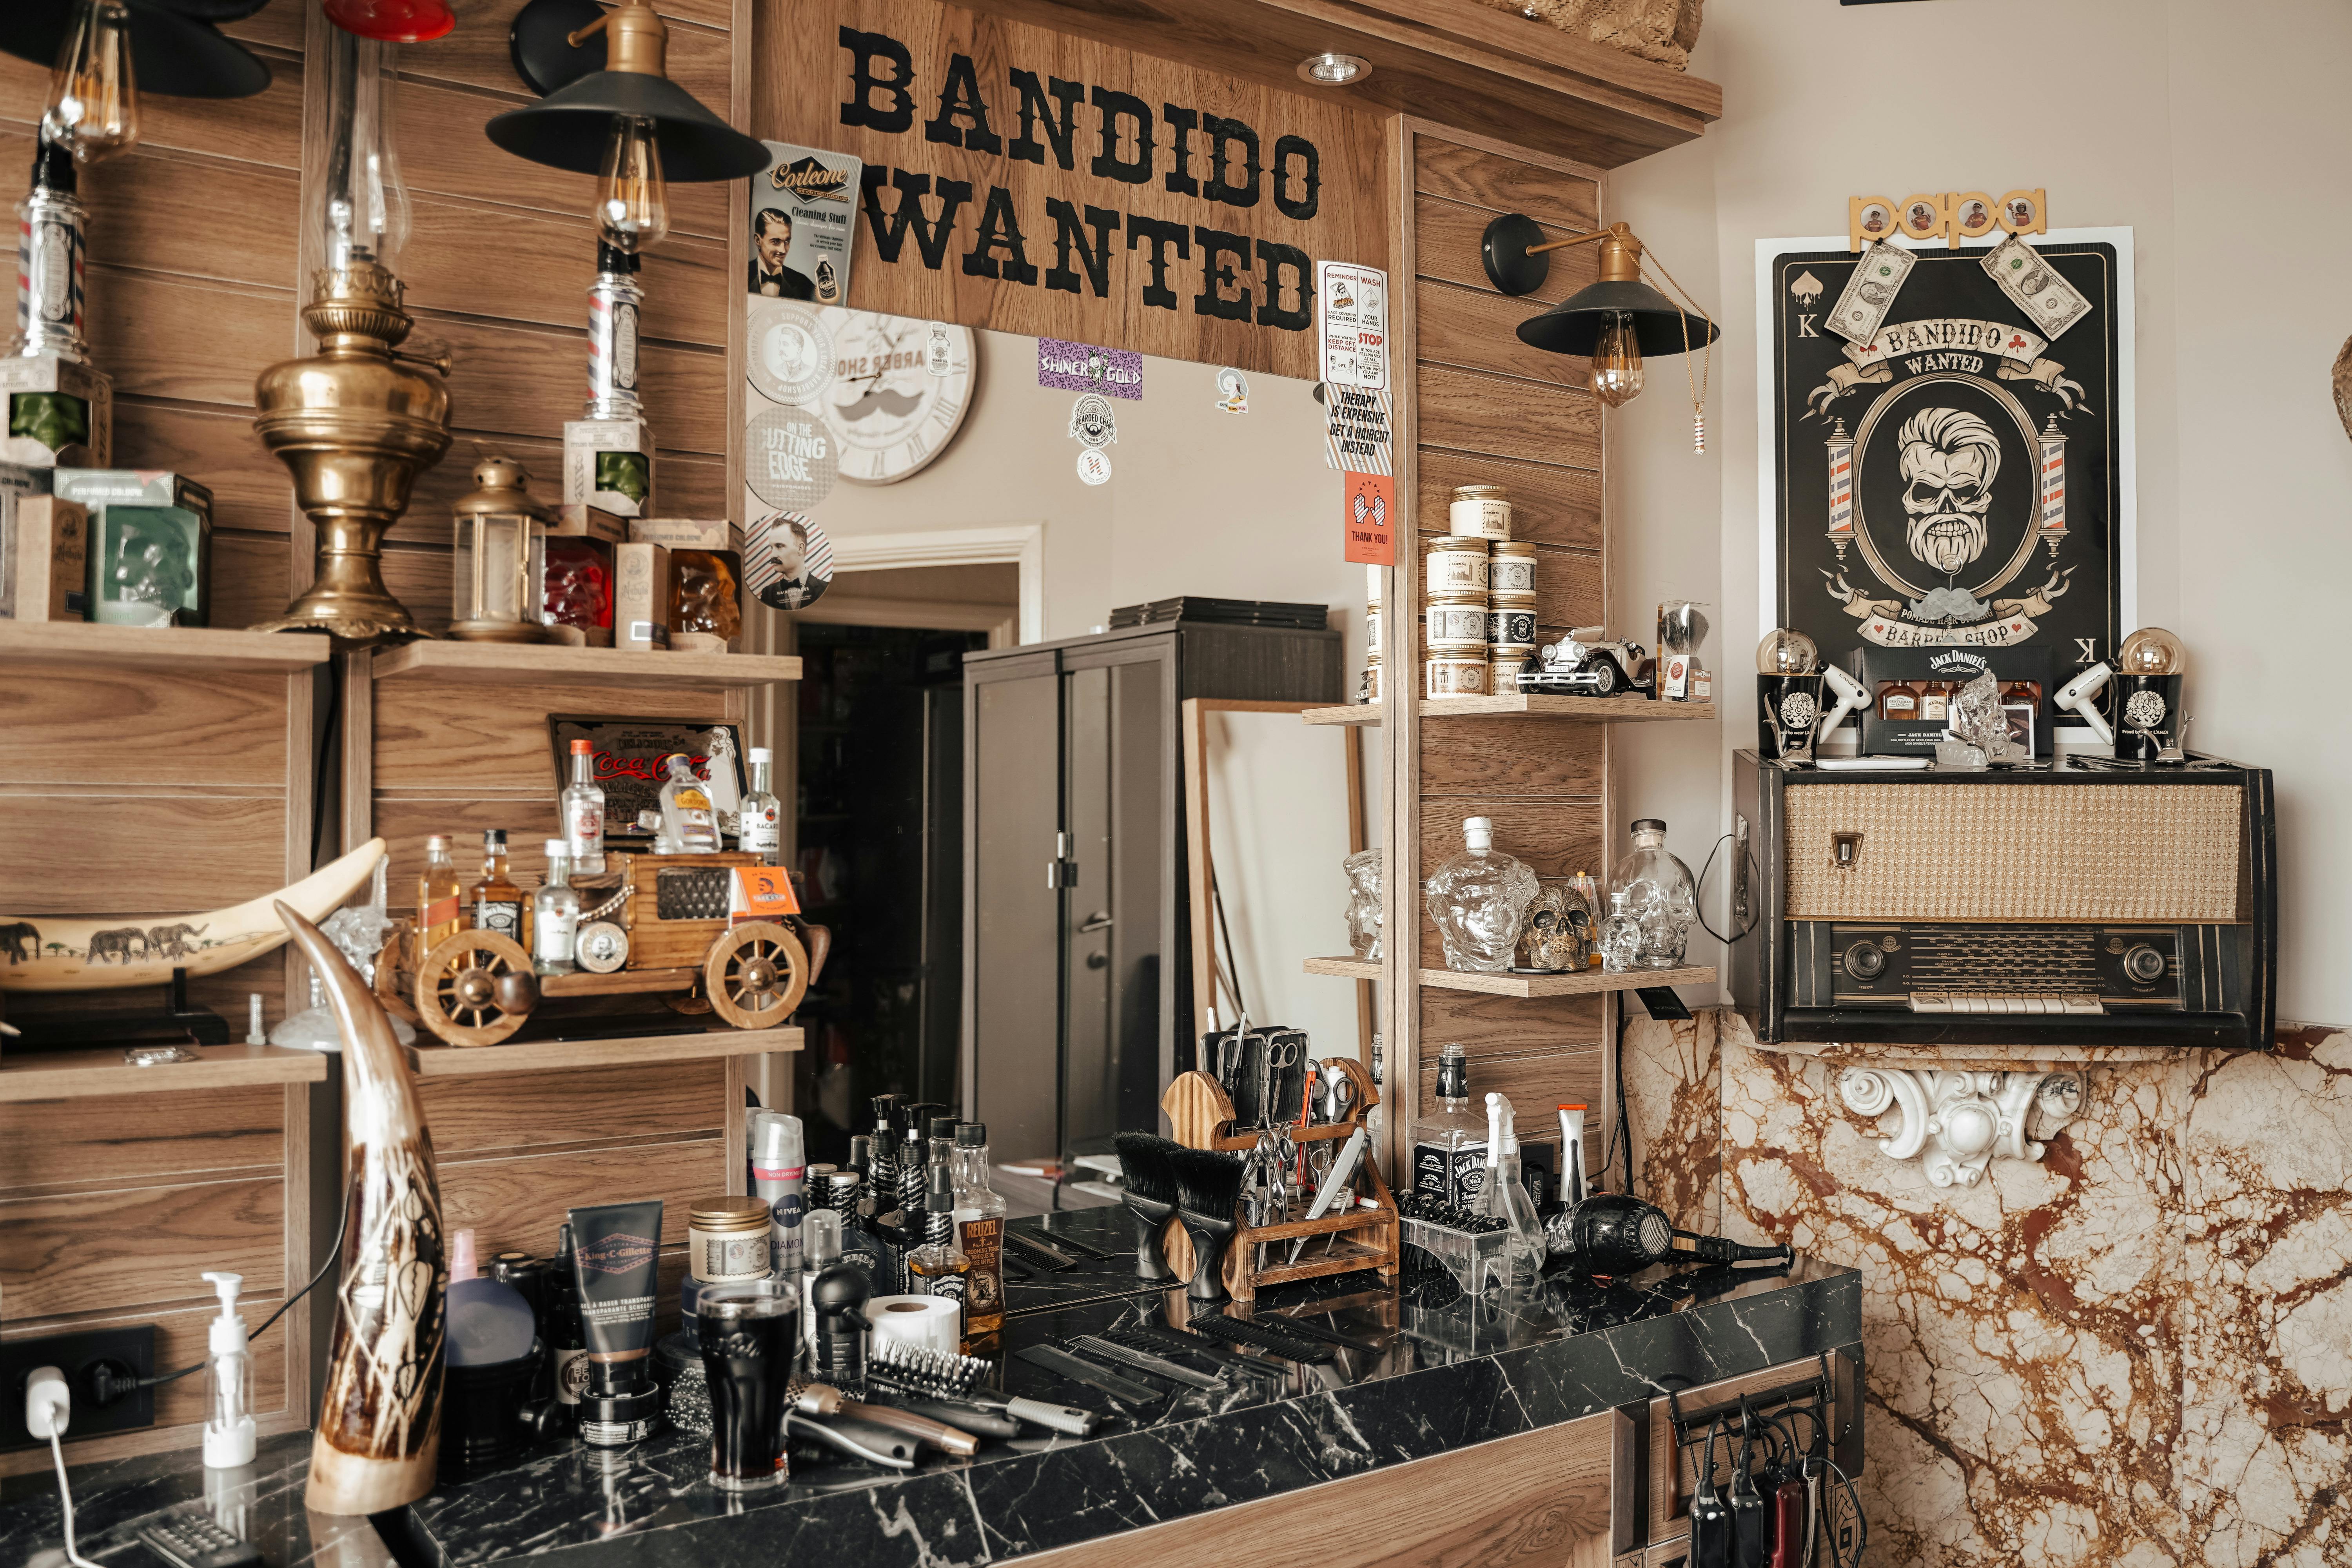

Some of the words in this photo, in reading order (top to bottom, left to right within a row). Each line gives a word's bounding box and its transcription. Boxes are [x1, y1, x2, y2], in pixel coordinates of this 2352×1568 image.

[839, 24, 1323, 221] BANDIDO
[771, 162, 848, 189] Corleone
[791, 207, 826, 222] Cleaning
[829, 211, 846, 224] Stuff
[1849, 189, 2046, 254] papa
[861, 164, 1317, 332] WANTED
[1327, 273, 1357, 281] REMINDER
[1361, 276, 1380, 287] WASH
[1843, 294, 1853, 310] UNITED
[1851, 278, 1861, 295] STATES
[1862, 255, 1875, 273] AMERICA
[782, 312, 814, 329] SUPPORT
[1797, 314, 1819, 338] K
[811, 328, 826, 348] YOUR
[1359, 332, 1382, 347] STOP
[1885, 322, 2002, 353] BANDIDO
[1328, 344, 1356, 352] DISTANCE
[819, 350, 828, 371] LOCAL
[1904, 353, 1984, 376] WANTED
[1041, 356, 1089, 377] SHINER
[1106, 366, 1141, 385] GOLD
[778, 370, 823, 394] BARBERSHOP
[1341, 392, 1376, 408] THERAPY
[1076, 414, 1098, 426] BEARDED
[1100, 416, 1112, 430] CHAP
[1331, 405, 1339, 417] IS
[1341, 407, 1385, 425] EXPENSIVE
[786, 422, 797, 433] ON
[799, 423, 813, 437] THE
[1330, 423, 1346, 437] GET
[1347, 426, 1353, 437] A
[1355, 426, 1389, 443] HAIRCUT
[759, 427, 826, 460] CUTTING
[1341, 440, 1375, 456] INSTEAD
[768, 450, 813, 482] EDGE
[73, 487, 110, 496] PERFUMED
[111, 488, 144, 496] COLOGNE
[1351, 531, 1372, 543] THANK
[1374, 534, 1388, 544] YOU!
[1512, 615, 1531, 624] BANDIDO
[1964, 626, 2008, 646] SHOP
[1931, 653, 1952, 670] JACK
[1952, 649, 1987, 669] DANIEL'S
[2074, 638, 2096, 662] K
[1839, 673, 1857, 691] L'ANZA
[1454, 1160, 1472, 1178] JACK
[777, 1206, 802, 1216] NIVEA
[967, 1220, 997, 1238] REUZEL
[771, 1238, 804, 1250] DIAMON
[582, 1305, 627, 1316] TRANSPARANTE
